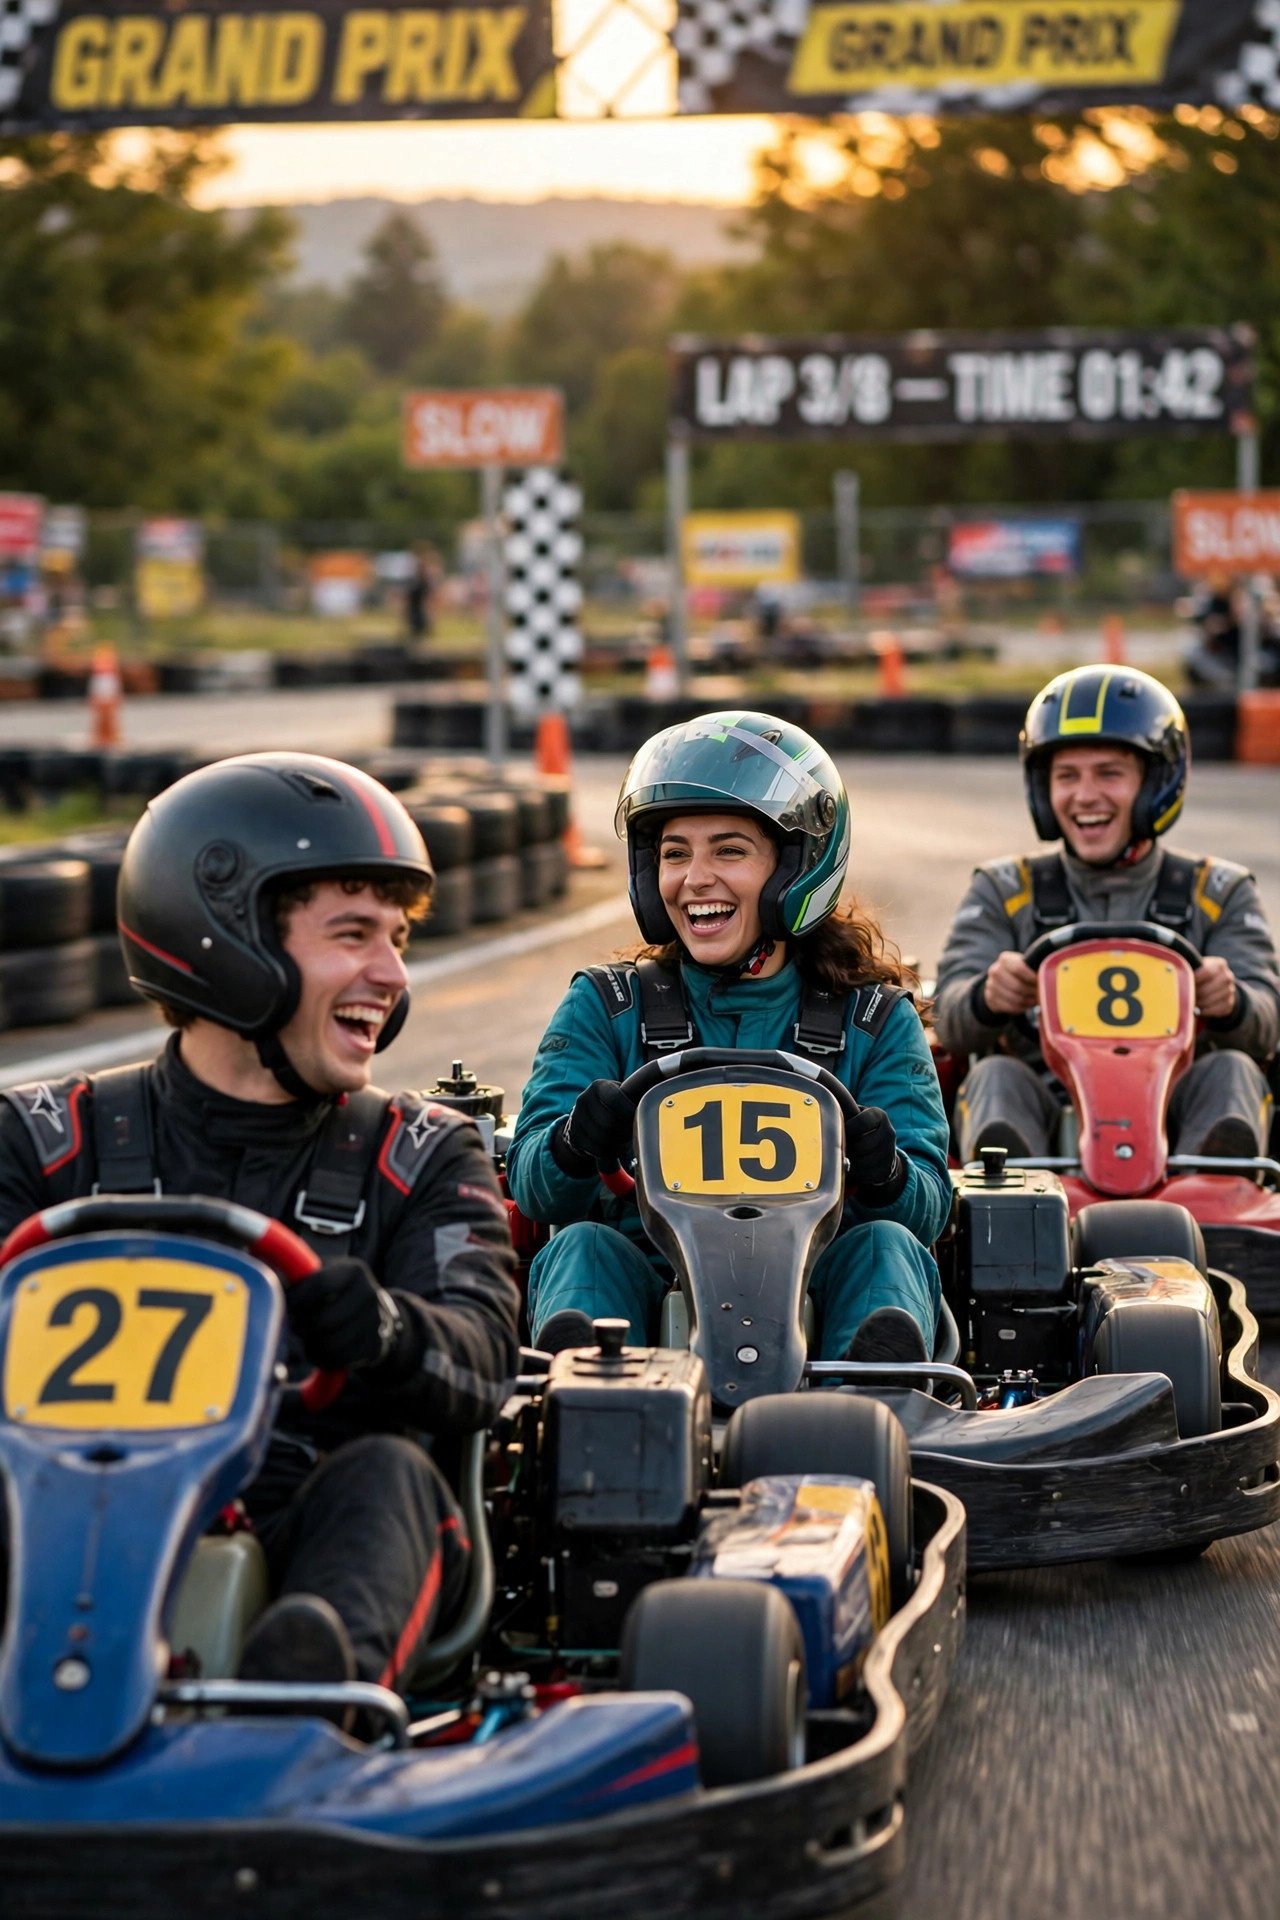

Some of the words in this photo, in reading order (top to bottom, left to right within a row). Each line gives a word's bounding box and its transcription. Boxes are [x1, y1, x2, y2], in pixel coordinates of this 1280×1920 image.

[51, 17, 324, 108] GRAND
[332, 10, 524, 101] PRIX
[828, 16, 1000, 74] GRAND
[1016, 11, 1141, 68] PRIX
[697, 356, 796, 426] LAP
[799, 353, 892, 425] 3/8
[948, 352, 1076, 422] TIME
[1079, 349, 1225, 419] 01:42
[416, 401, 548, 457] SLOW
[1097, 967, 1144, 1027] 8
[683, 1100, 797, 1182] 15
[39, 1288, 214, 1406] 27
